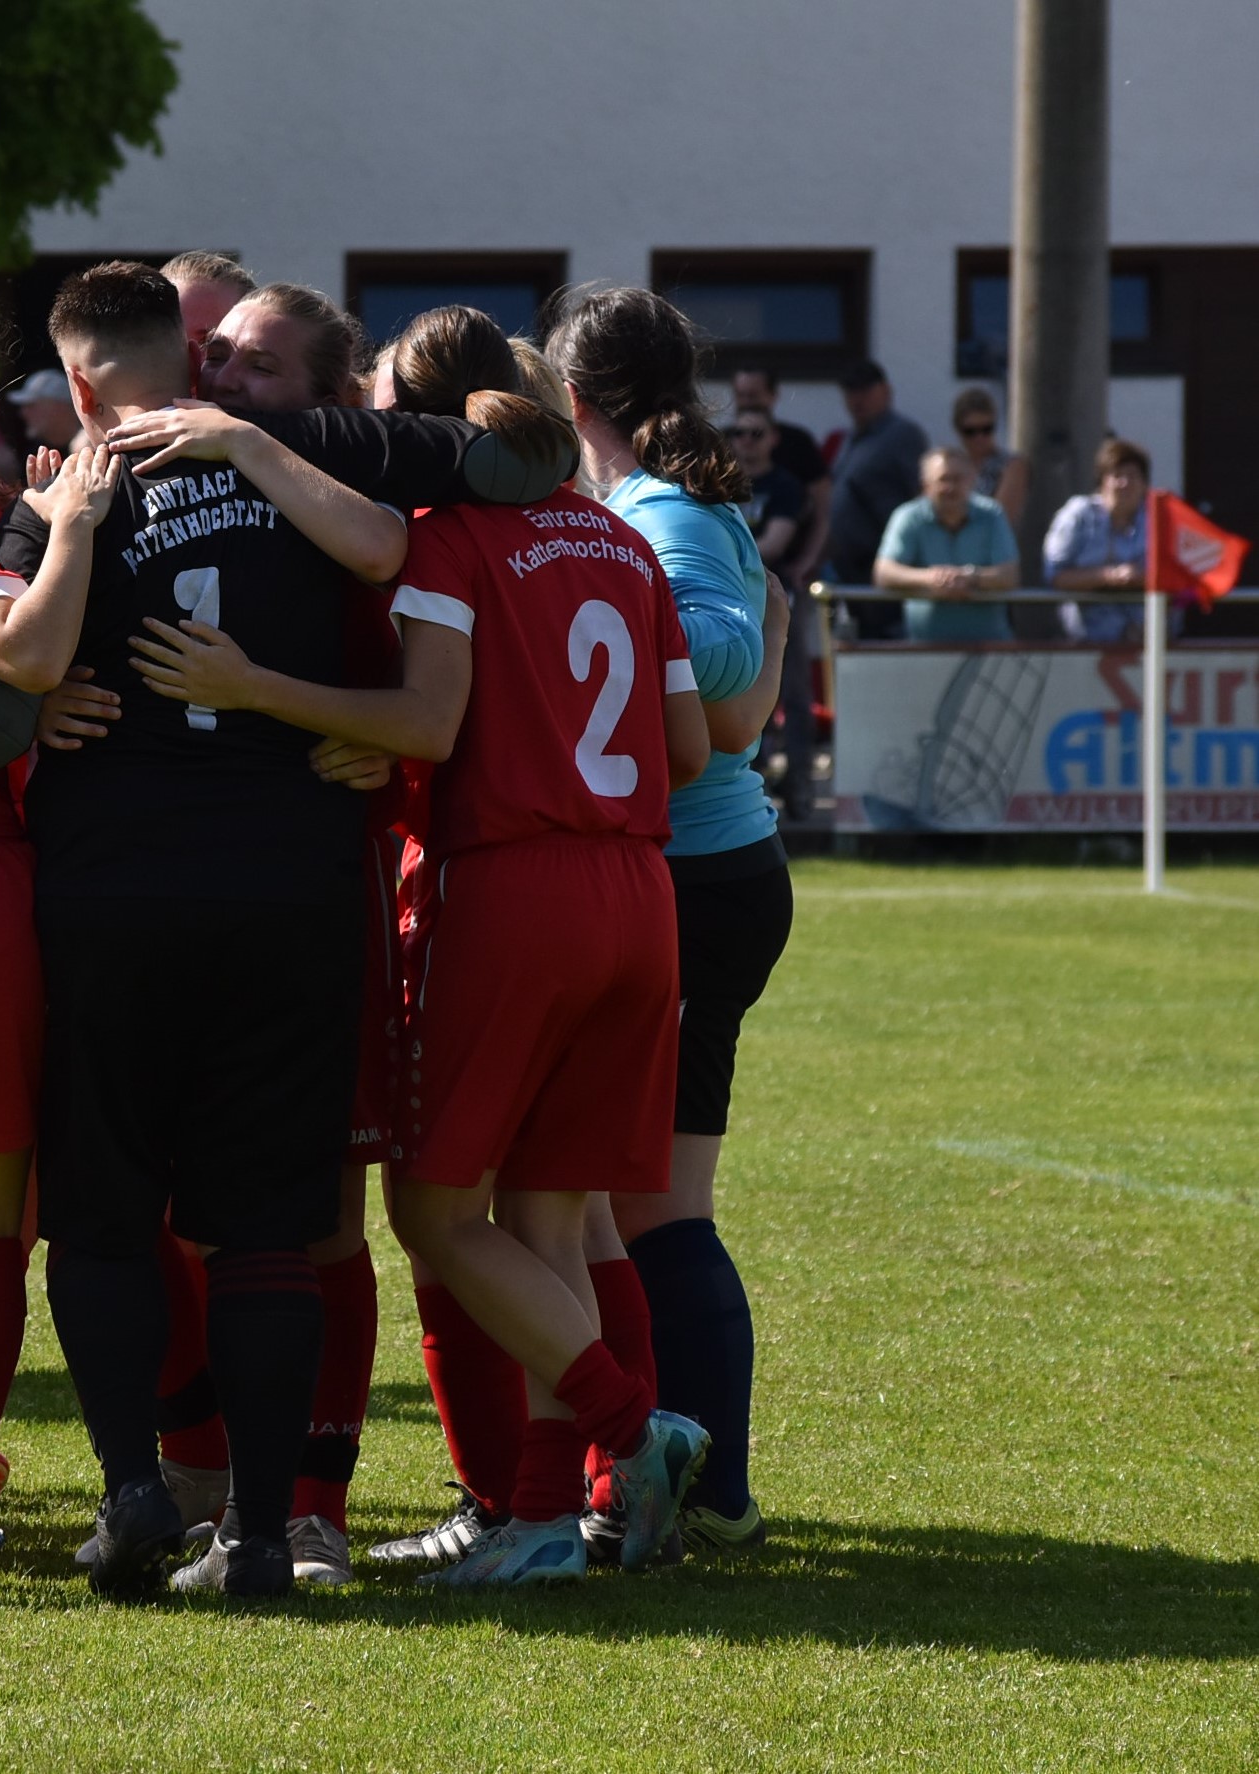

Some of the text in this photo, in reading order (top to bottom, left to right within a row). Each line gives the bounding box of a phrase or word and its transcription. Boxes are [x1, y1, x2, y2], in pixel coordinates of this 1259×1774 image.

[522, 509, 613, 534] Eintracht
[507, 537, 655, 587] Kattenhochstatt
[568, 599, 639, 797] 2
[307, 1421, 361, 1435] JAKO
